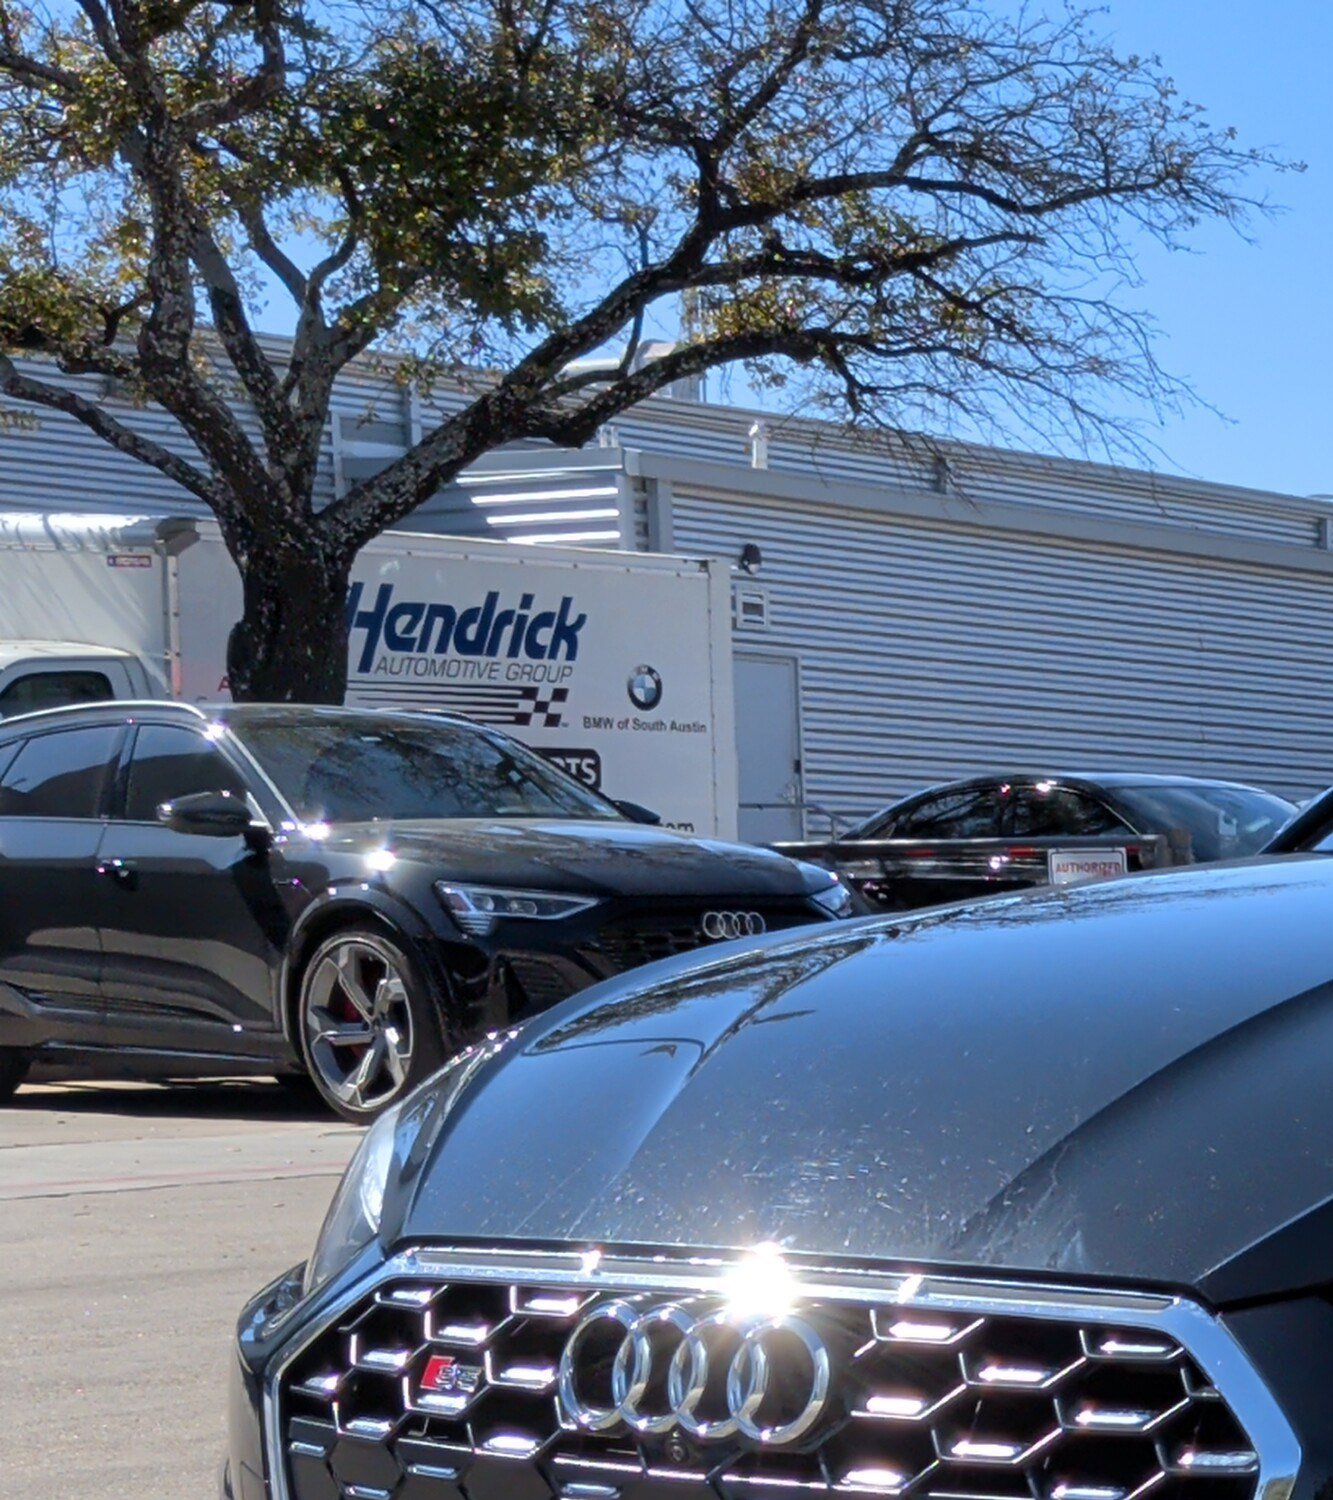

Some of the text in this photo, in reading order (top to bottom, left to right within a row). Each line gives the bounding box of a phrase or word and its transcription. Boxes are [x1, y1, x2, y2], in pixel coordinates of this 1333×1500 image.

[347, 581, 588, 674] Hendrick
[374, 655, 573, 683] AUTOMOTIVE GROUP
[582, 716, 707, 733] BMW of South Austin
